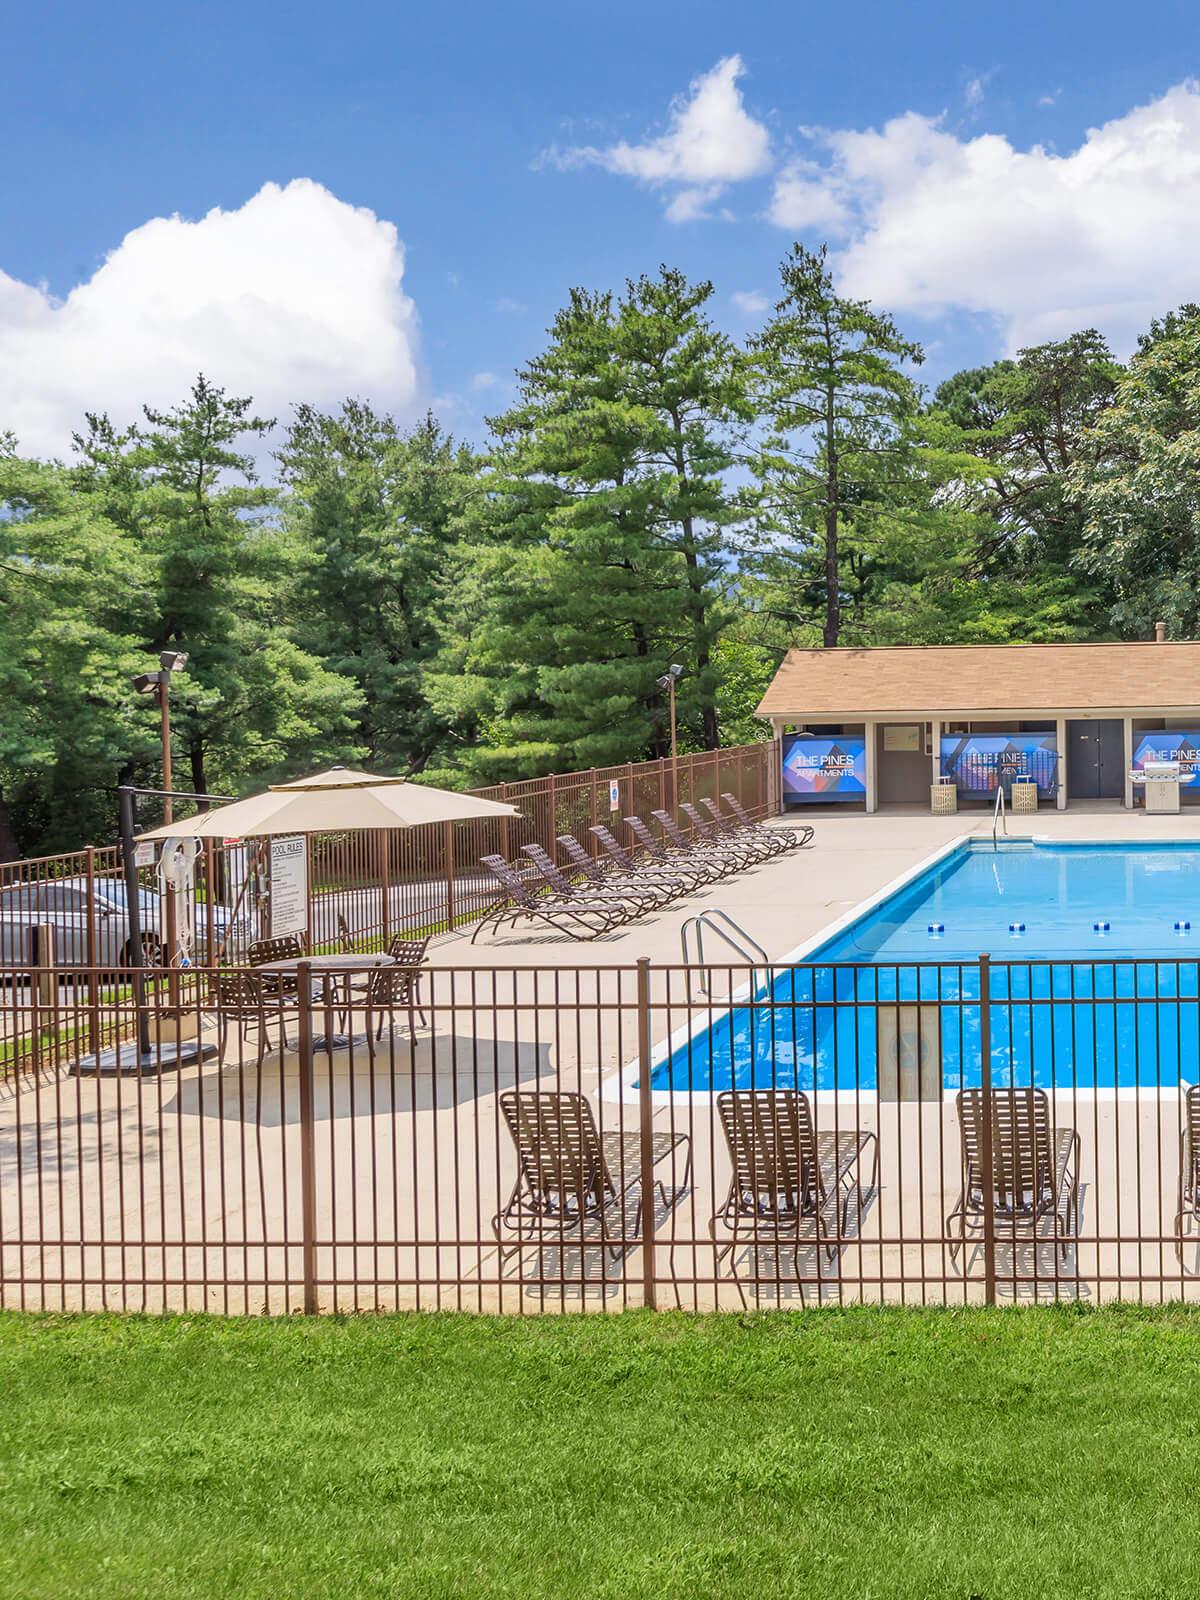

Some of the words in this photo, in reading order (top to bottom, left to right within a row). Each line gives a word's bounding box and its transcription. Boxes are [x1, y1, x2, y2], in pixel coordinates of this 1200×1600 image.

[796, 755, 818, 766] THE
[820, 754, 855, 765] PINES
[1146, 750, 1169, 761] THE
[796, 768, 855, 777] APARTMENTS
